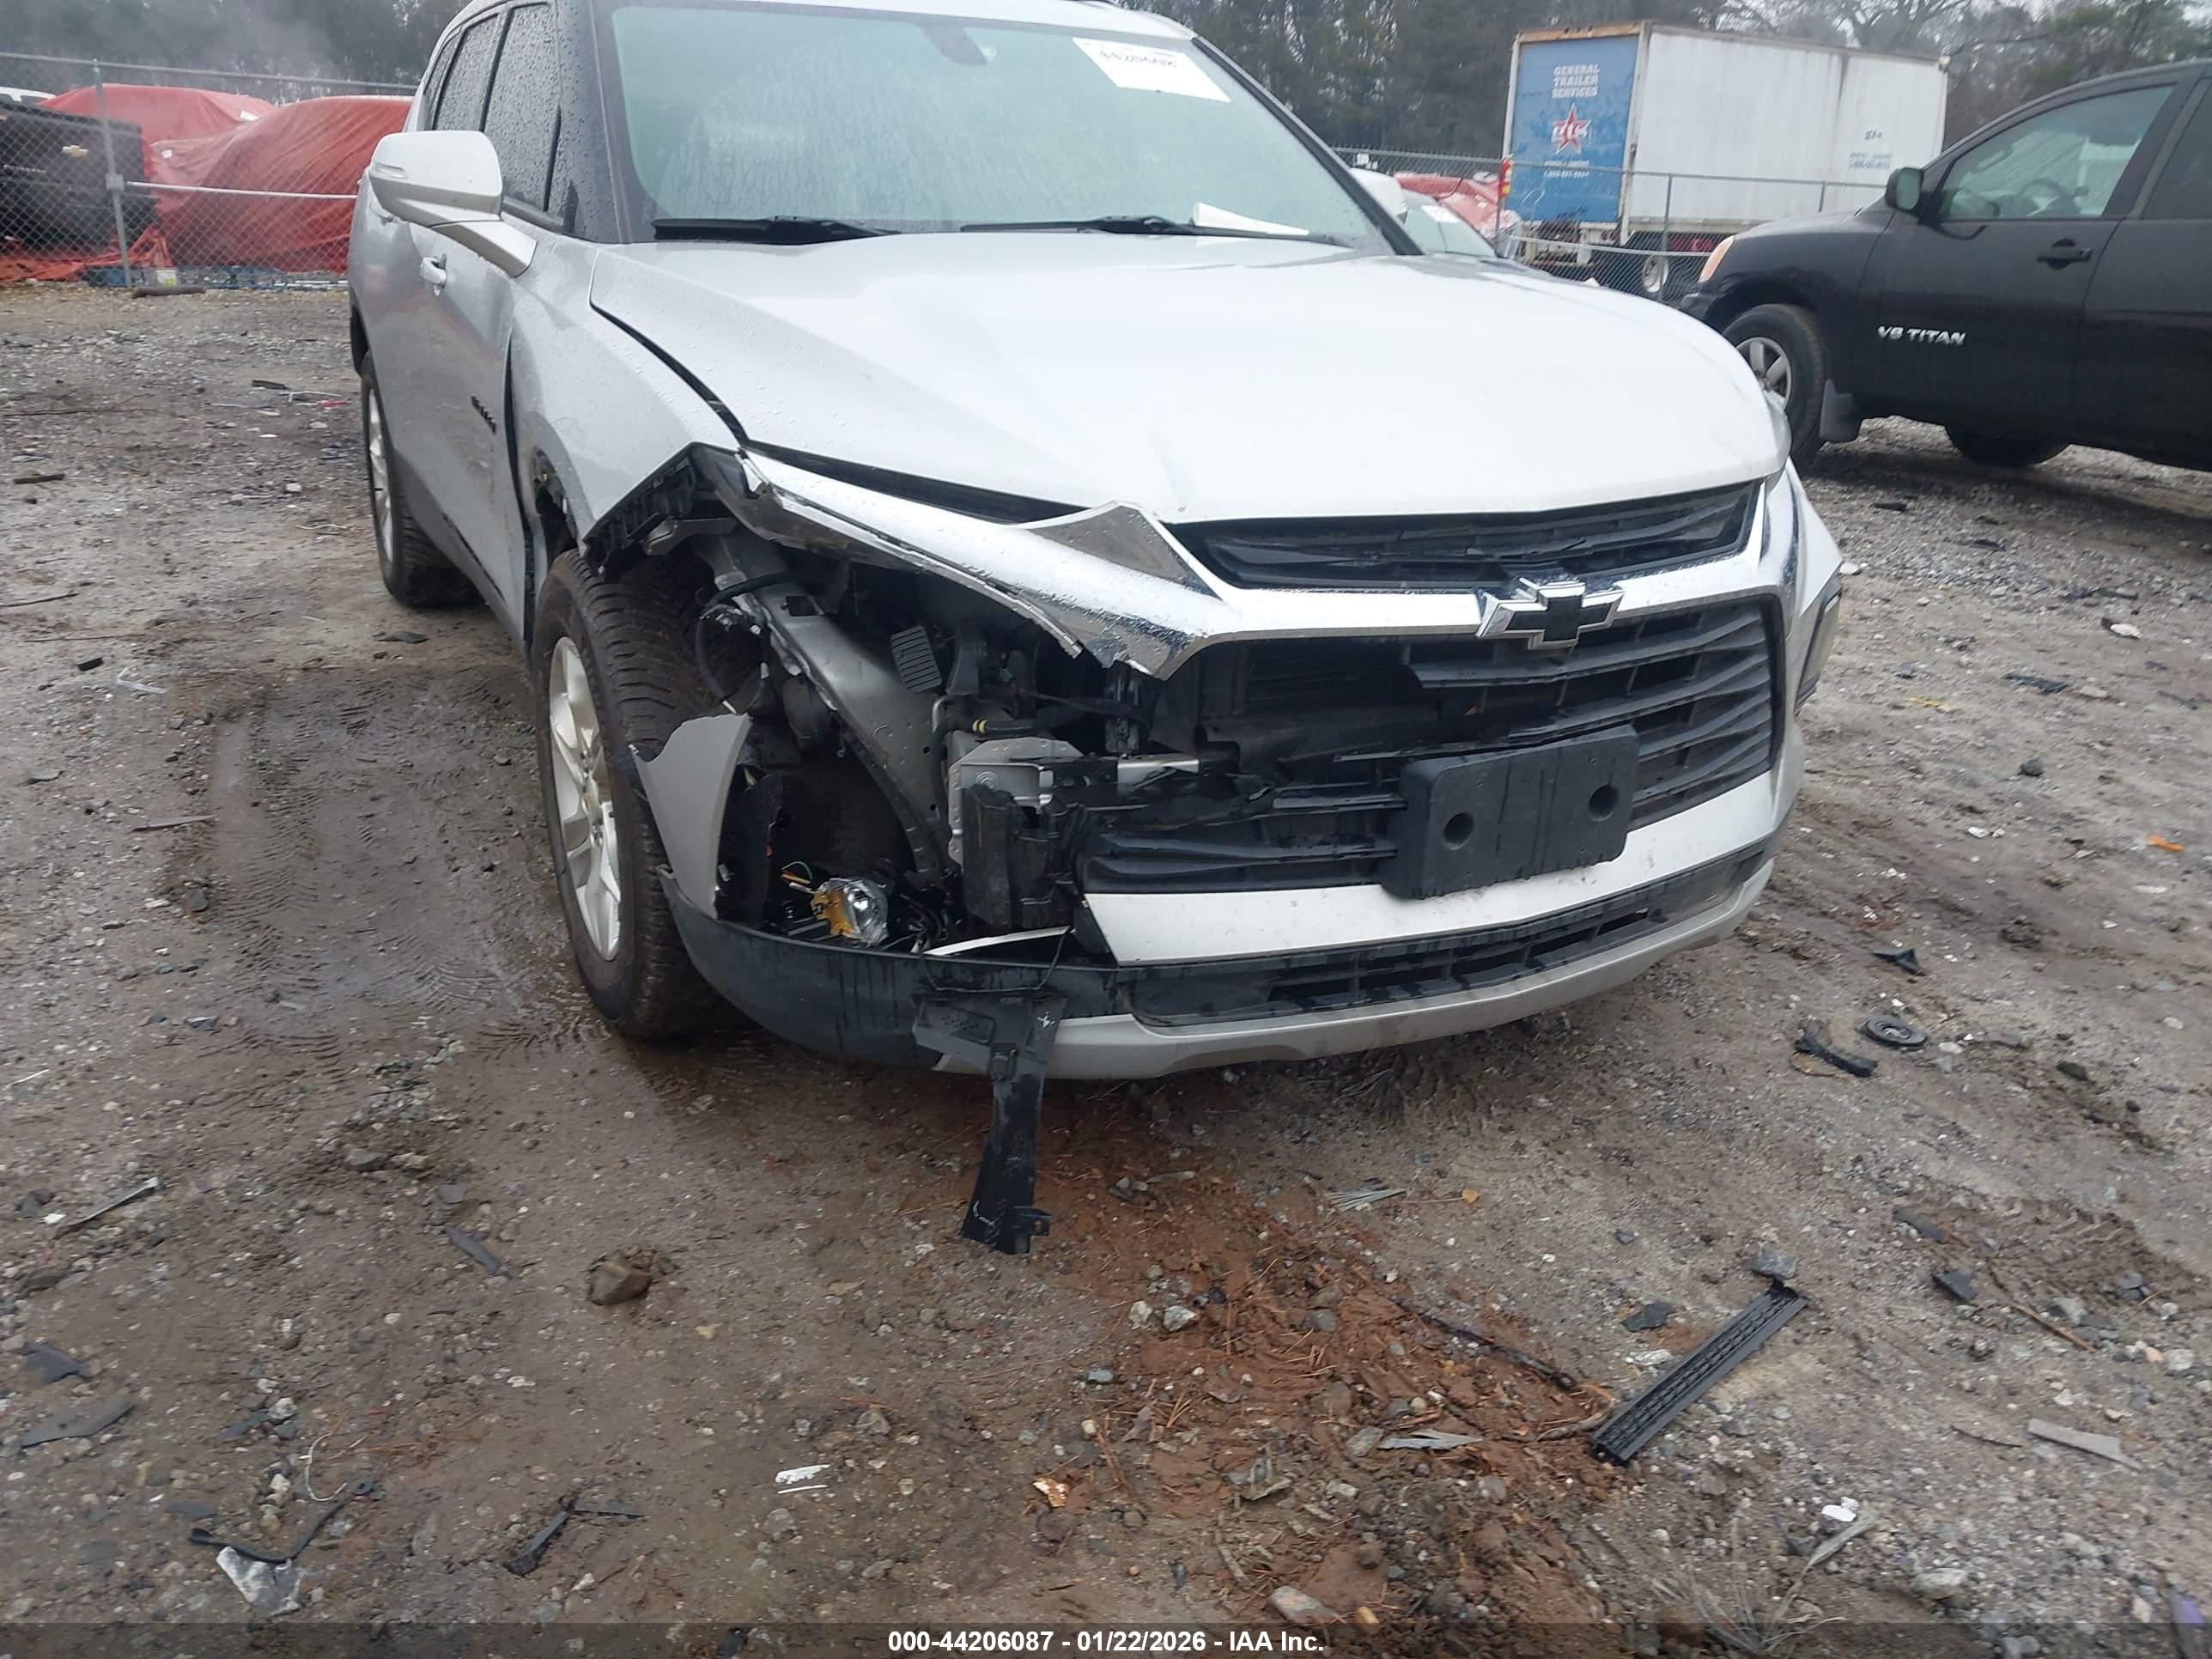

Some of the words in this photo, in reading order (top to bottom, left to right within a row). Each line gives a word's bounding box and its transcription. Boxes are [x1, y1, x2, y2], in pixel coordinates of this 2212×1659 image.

[1553, 63, 1600, 76] GENERAL
[1553, 75, 1599, 87] TRAILER
[1552, 87, 1598, 99] SERVICES
[1877, 325, 1904, 340] V8
[1906, 328, 1966, 345] TITAN
